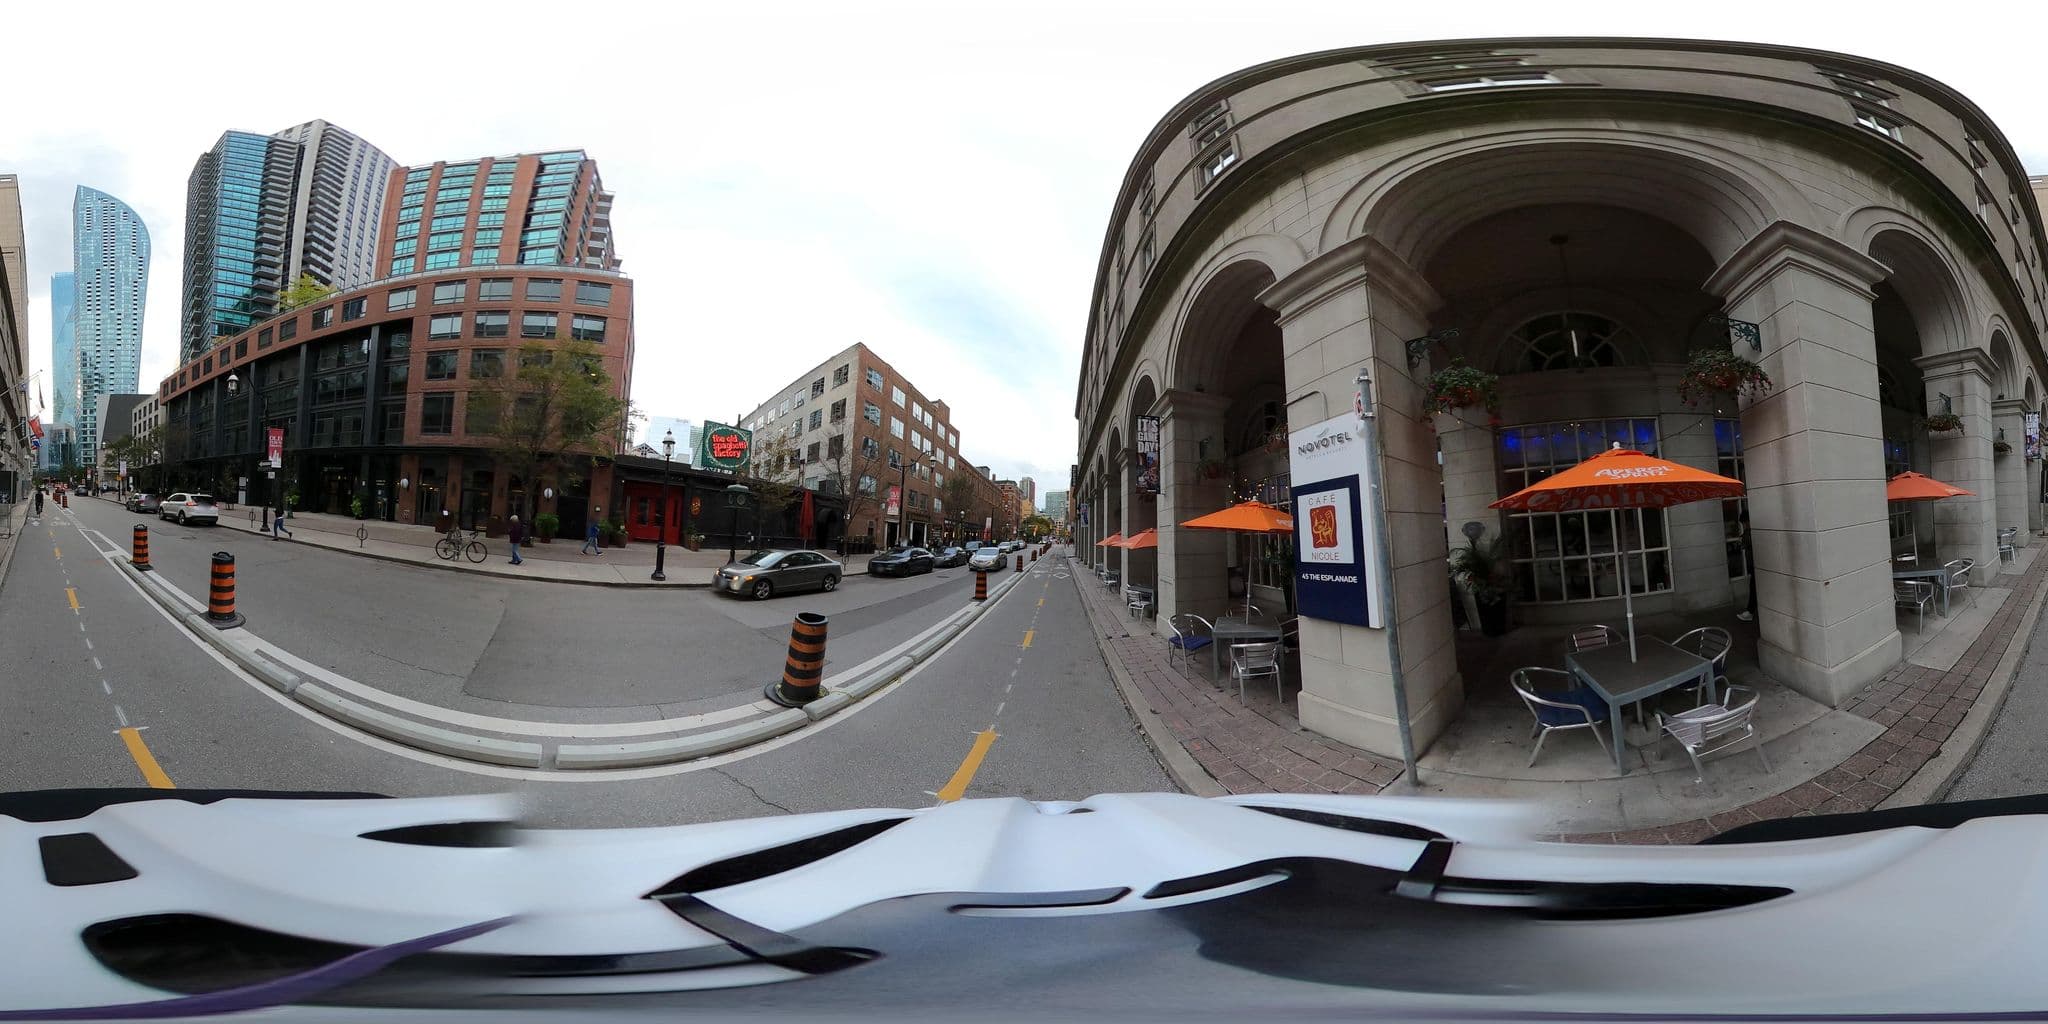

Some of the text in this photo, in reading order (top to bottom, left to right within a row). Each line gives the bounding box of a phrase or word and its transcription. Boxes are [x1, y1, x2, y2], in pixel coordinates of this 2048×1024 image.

[1137, 418, 1159, 433] IT'S
[726, 434, 738, 442] old
[1137, 431, 1159, 442] GAME
[1137, 441, 1159, 454] DAY!
[1298, 432, 1352, 456] NOVOTEL
[1594, 466, 1674, 477] APEROL
[1311, 552, 1340, 561] NICOLE
[1309, 573, 1320, 581] THE
[1320, 574, 1358, 584] ESPLANADE
